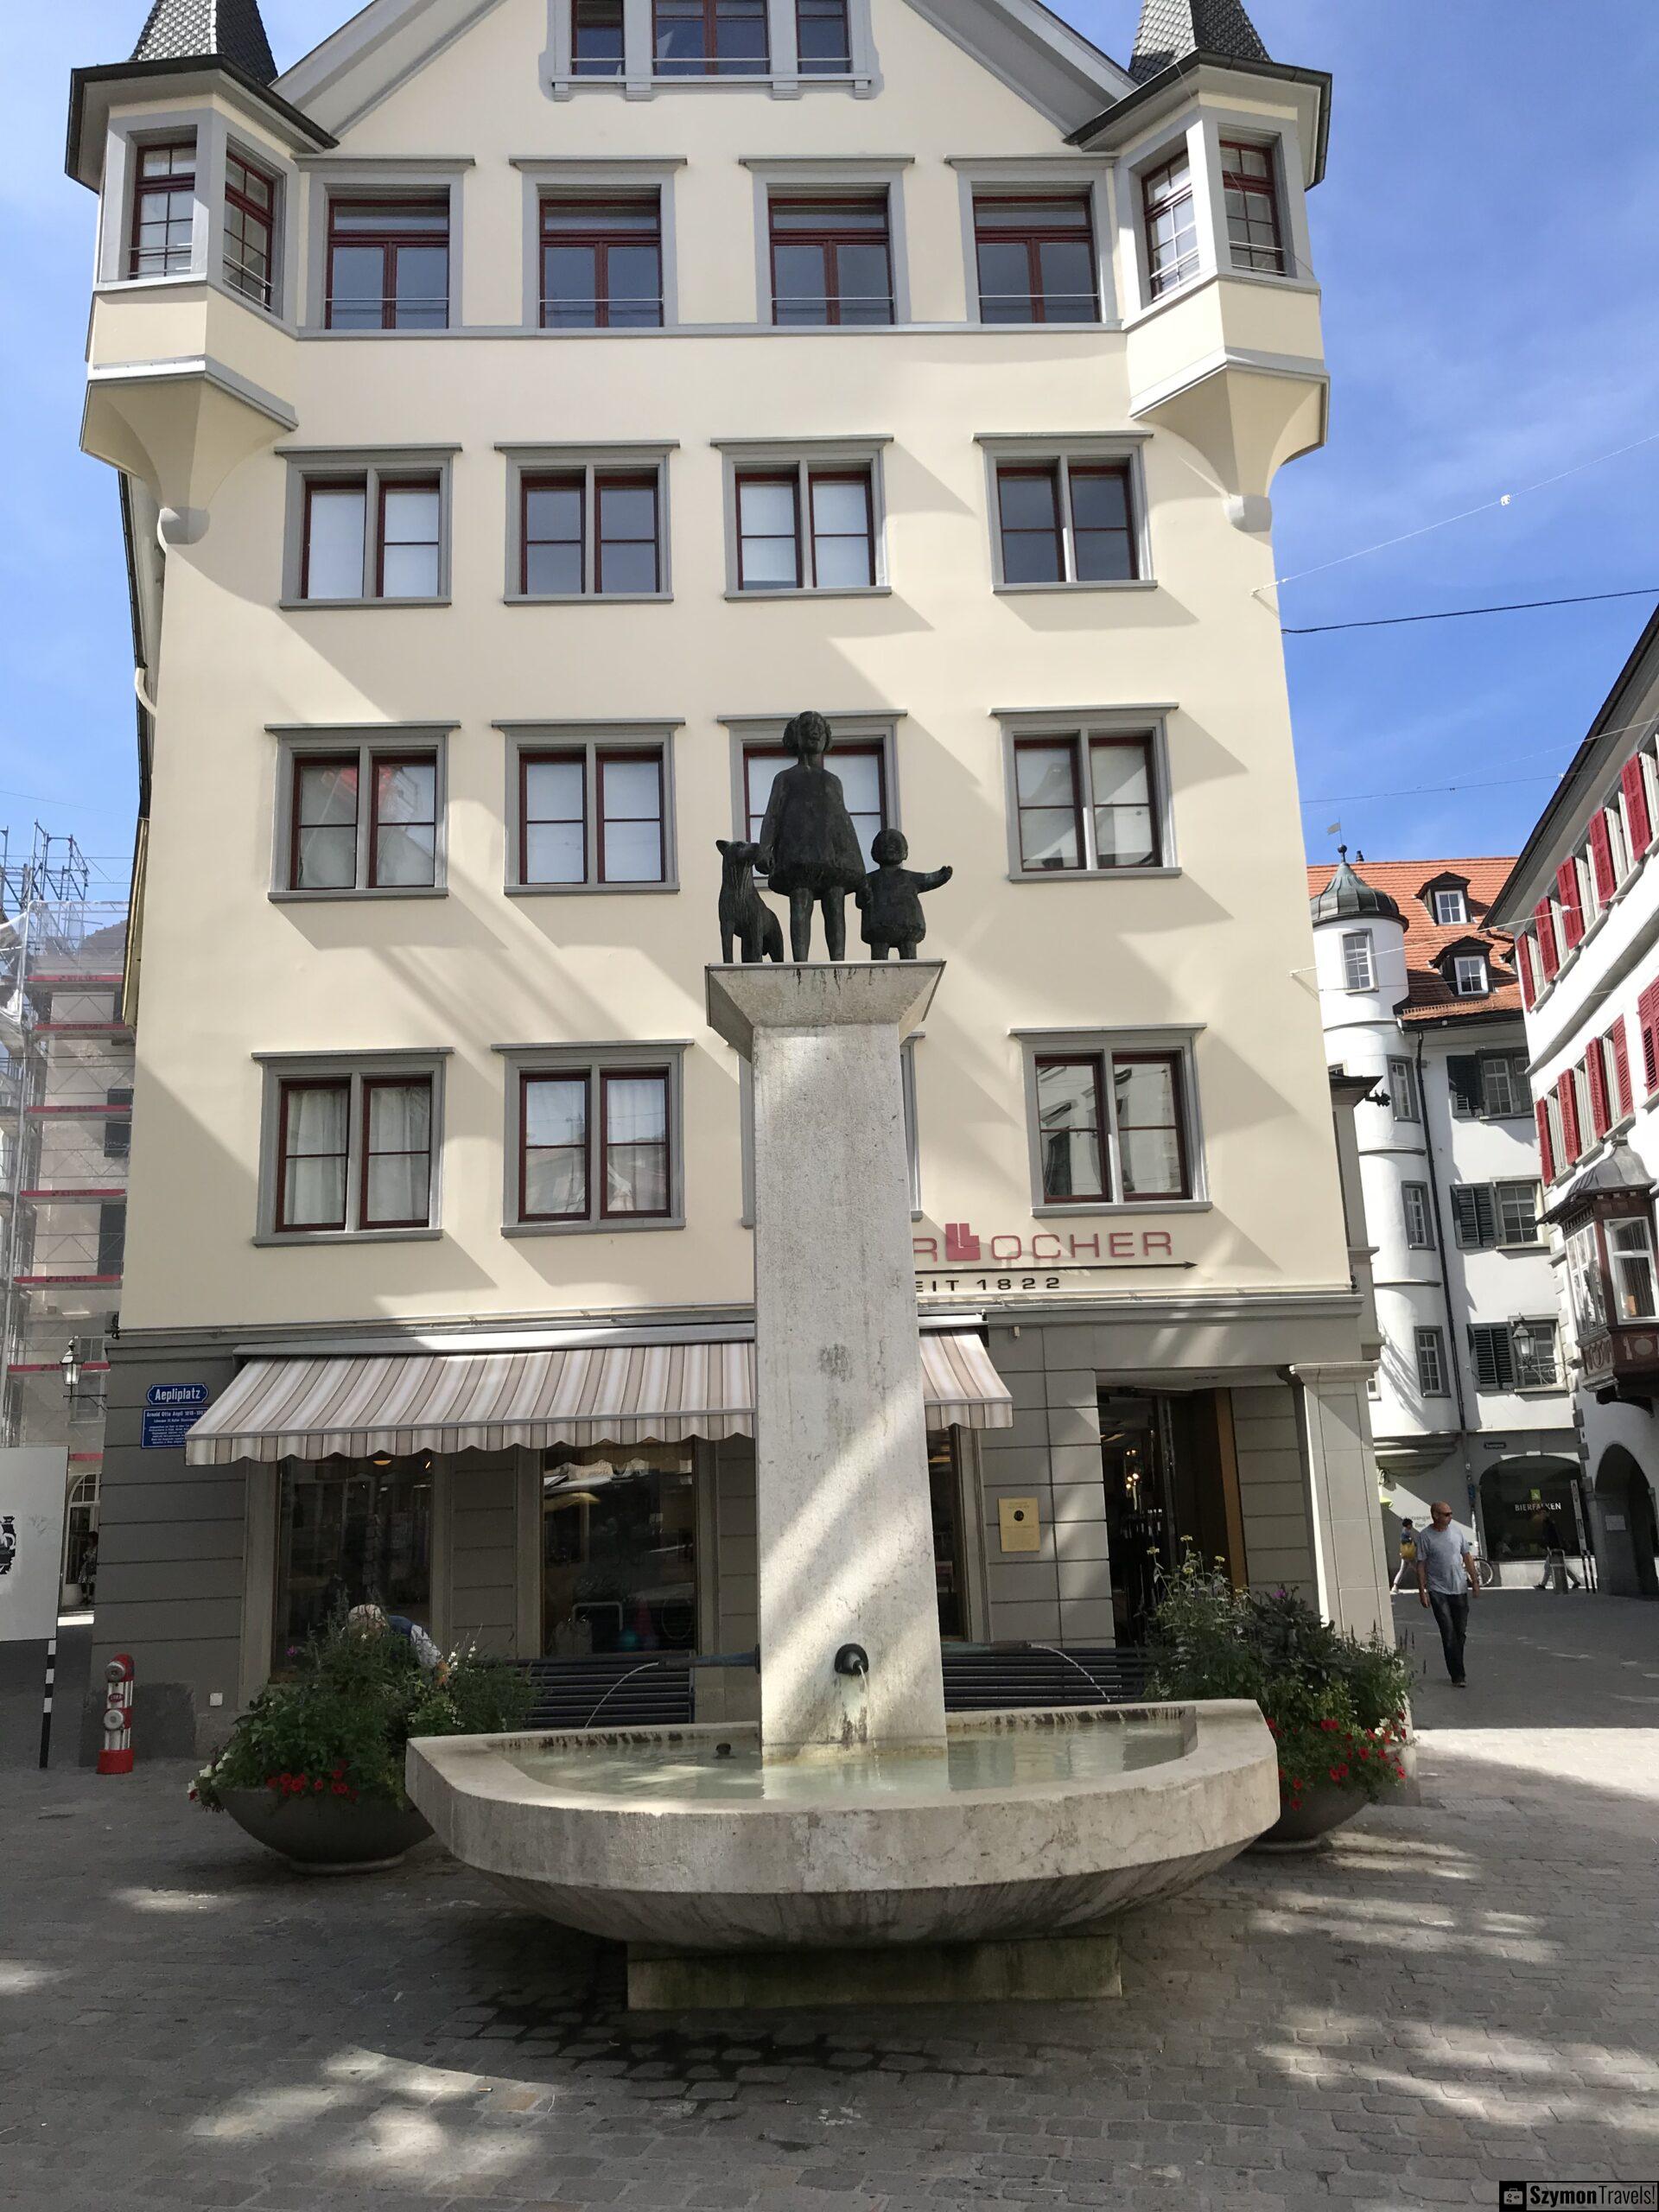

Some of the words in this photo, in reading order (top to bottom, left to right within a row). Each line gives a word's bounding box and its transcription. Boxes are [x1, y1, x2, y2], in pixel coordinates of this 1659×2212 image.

[915, 1280, 959, 1293] EIT
[976, 1277, 1060, 1291] 1822
[155, 1387, 200, 1402] Aepliplatz
